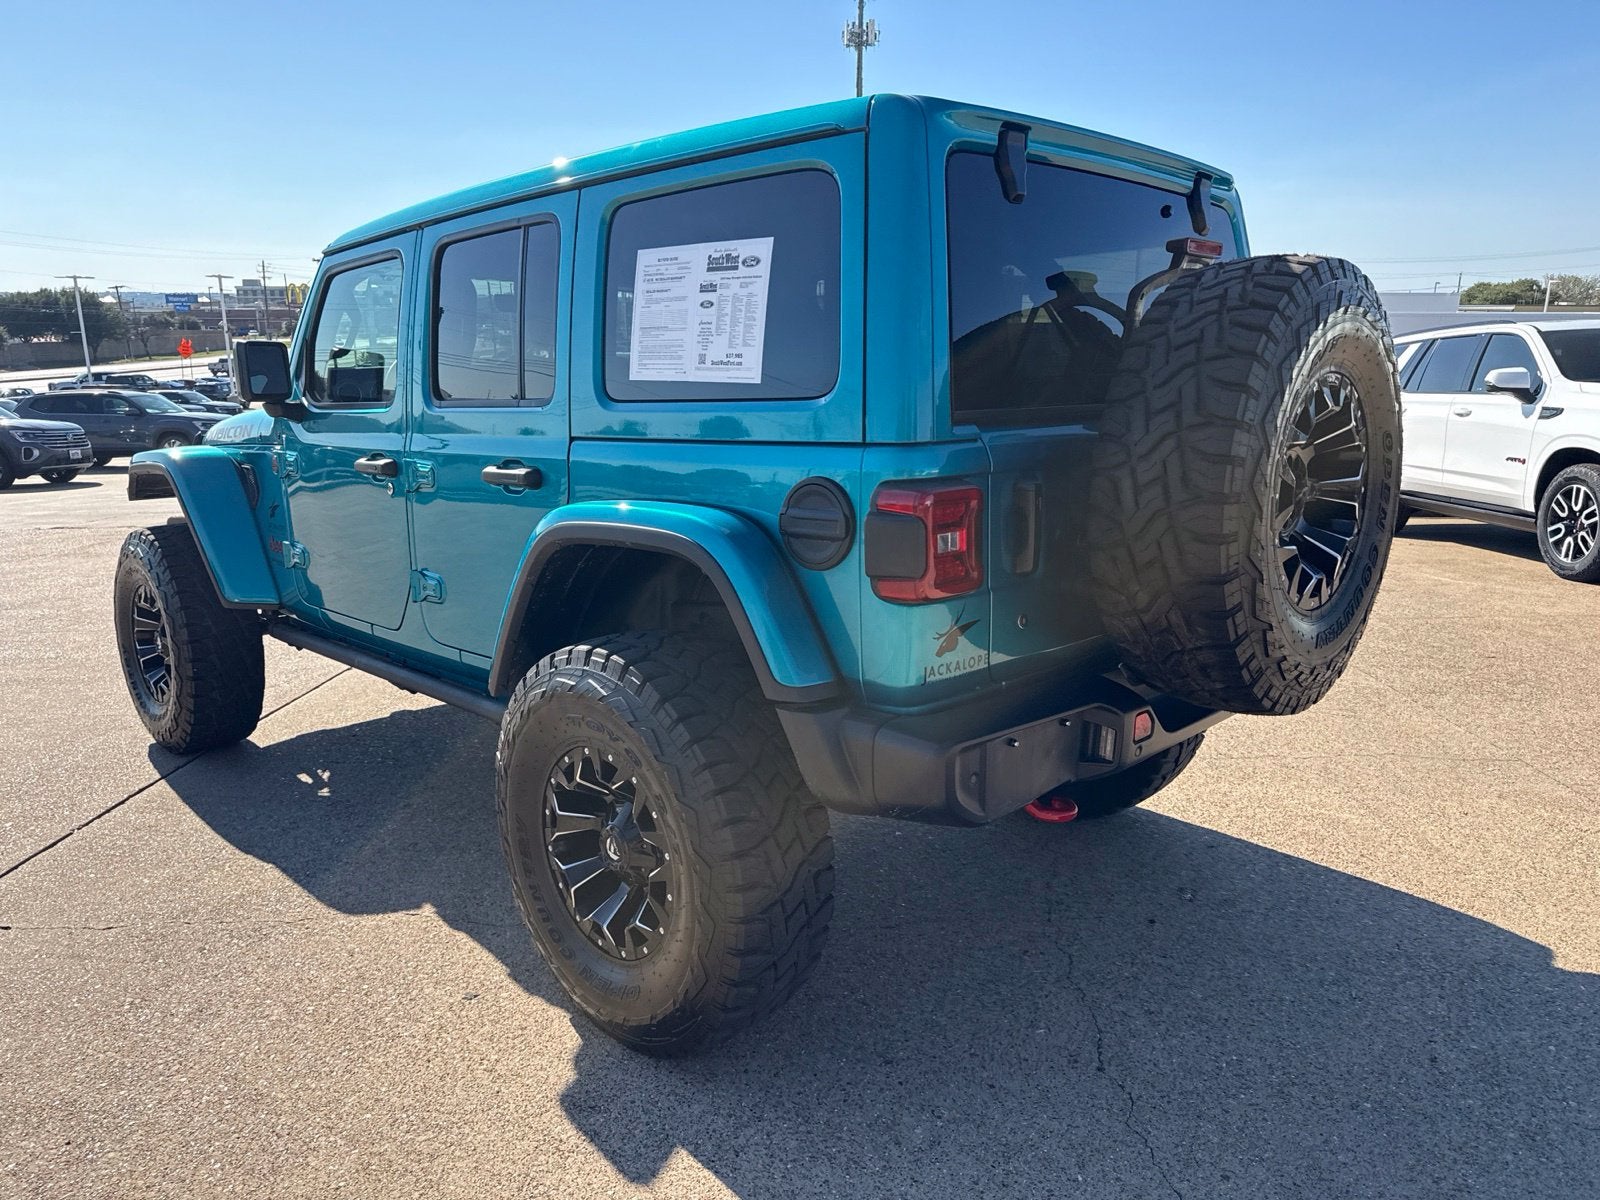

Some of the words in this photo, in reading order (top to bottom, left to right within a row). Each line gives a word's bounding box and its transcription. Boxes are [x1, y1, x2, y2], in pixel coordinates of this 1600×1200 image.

[1376, 431, 1394, 534] OPEN
[1315, 542, 1379, 649] COUNTRY
[921, 653, 989, 686] JACKALOPE
